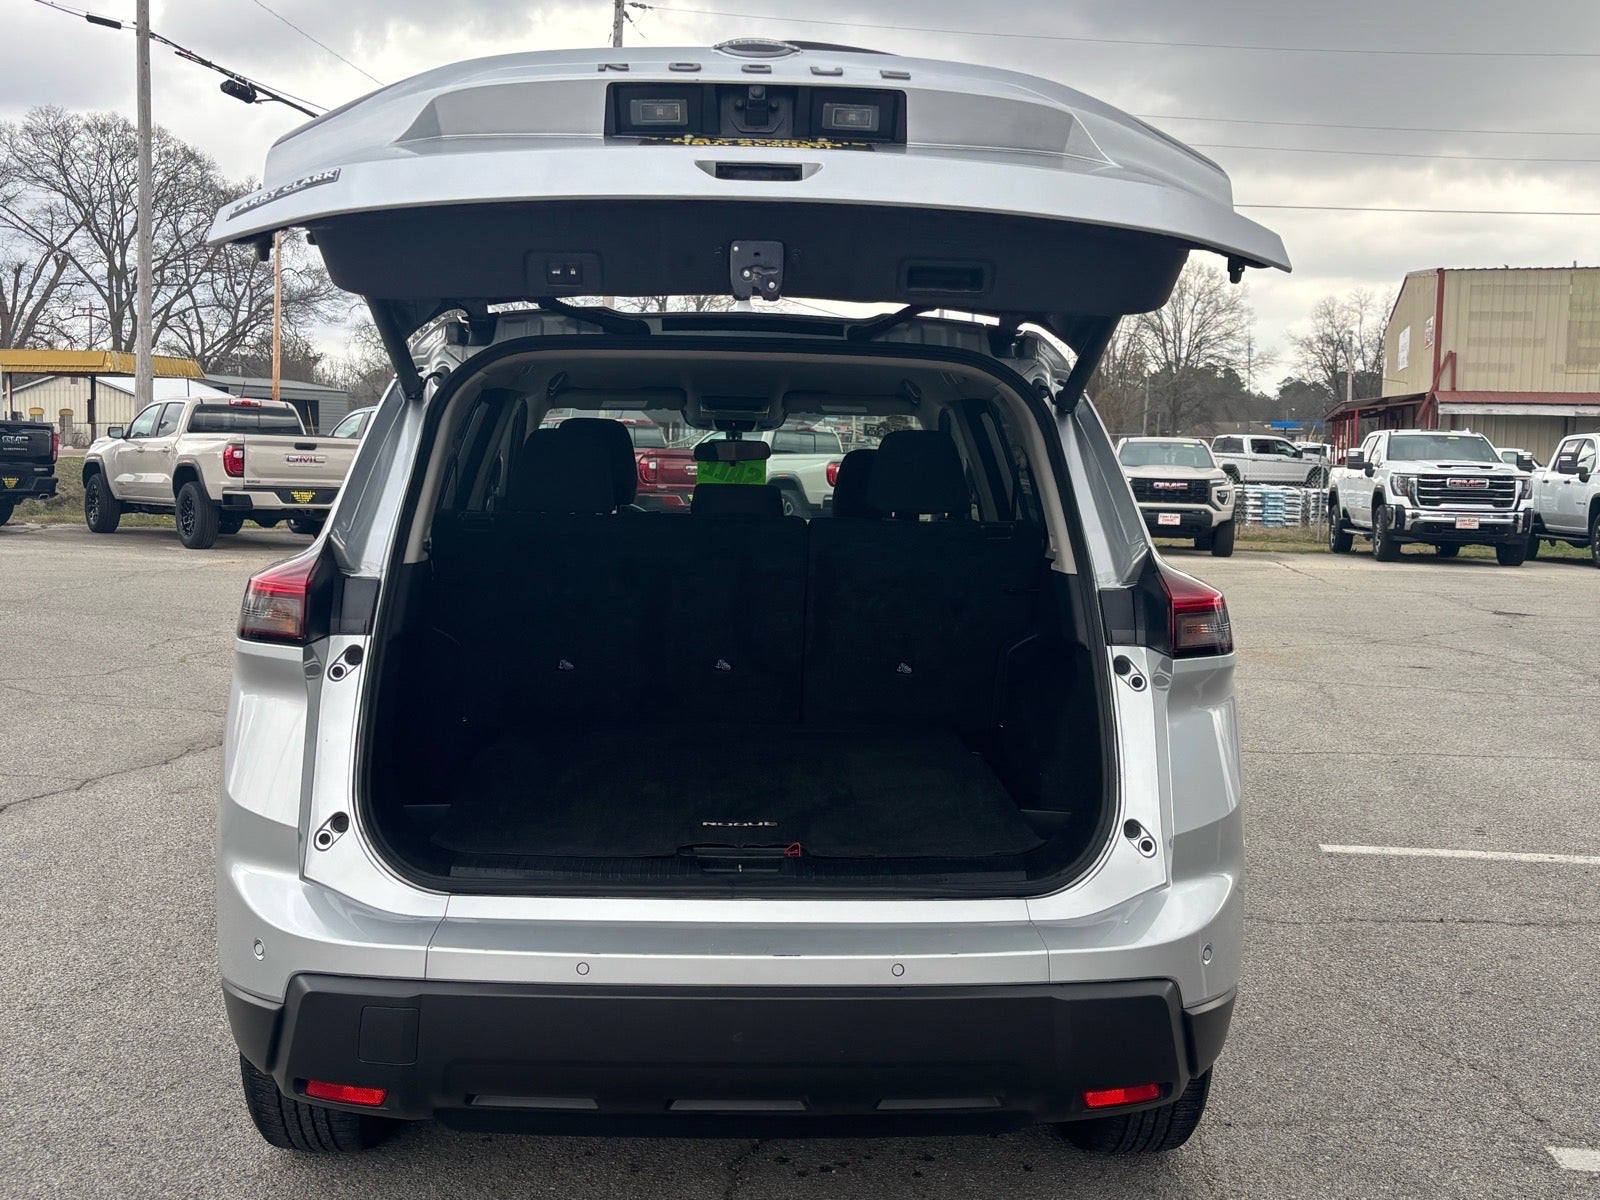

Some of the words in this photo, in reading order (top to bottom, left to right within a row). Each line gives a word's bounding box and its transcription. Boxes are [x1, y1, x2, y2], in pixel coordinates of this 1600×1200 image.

[231, 188, 280, 214] LARRY
[282, 171, 336, 192] CLARK
[285, 454, 326, 464] GMC
[1153, 481, 1188, 489] GMC
[1449, 479, 1487, 488] GMC
